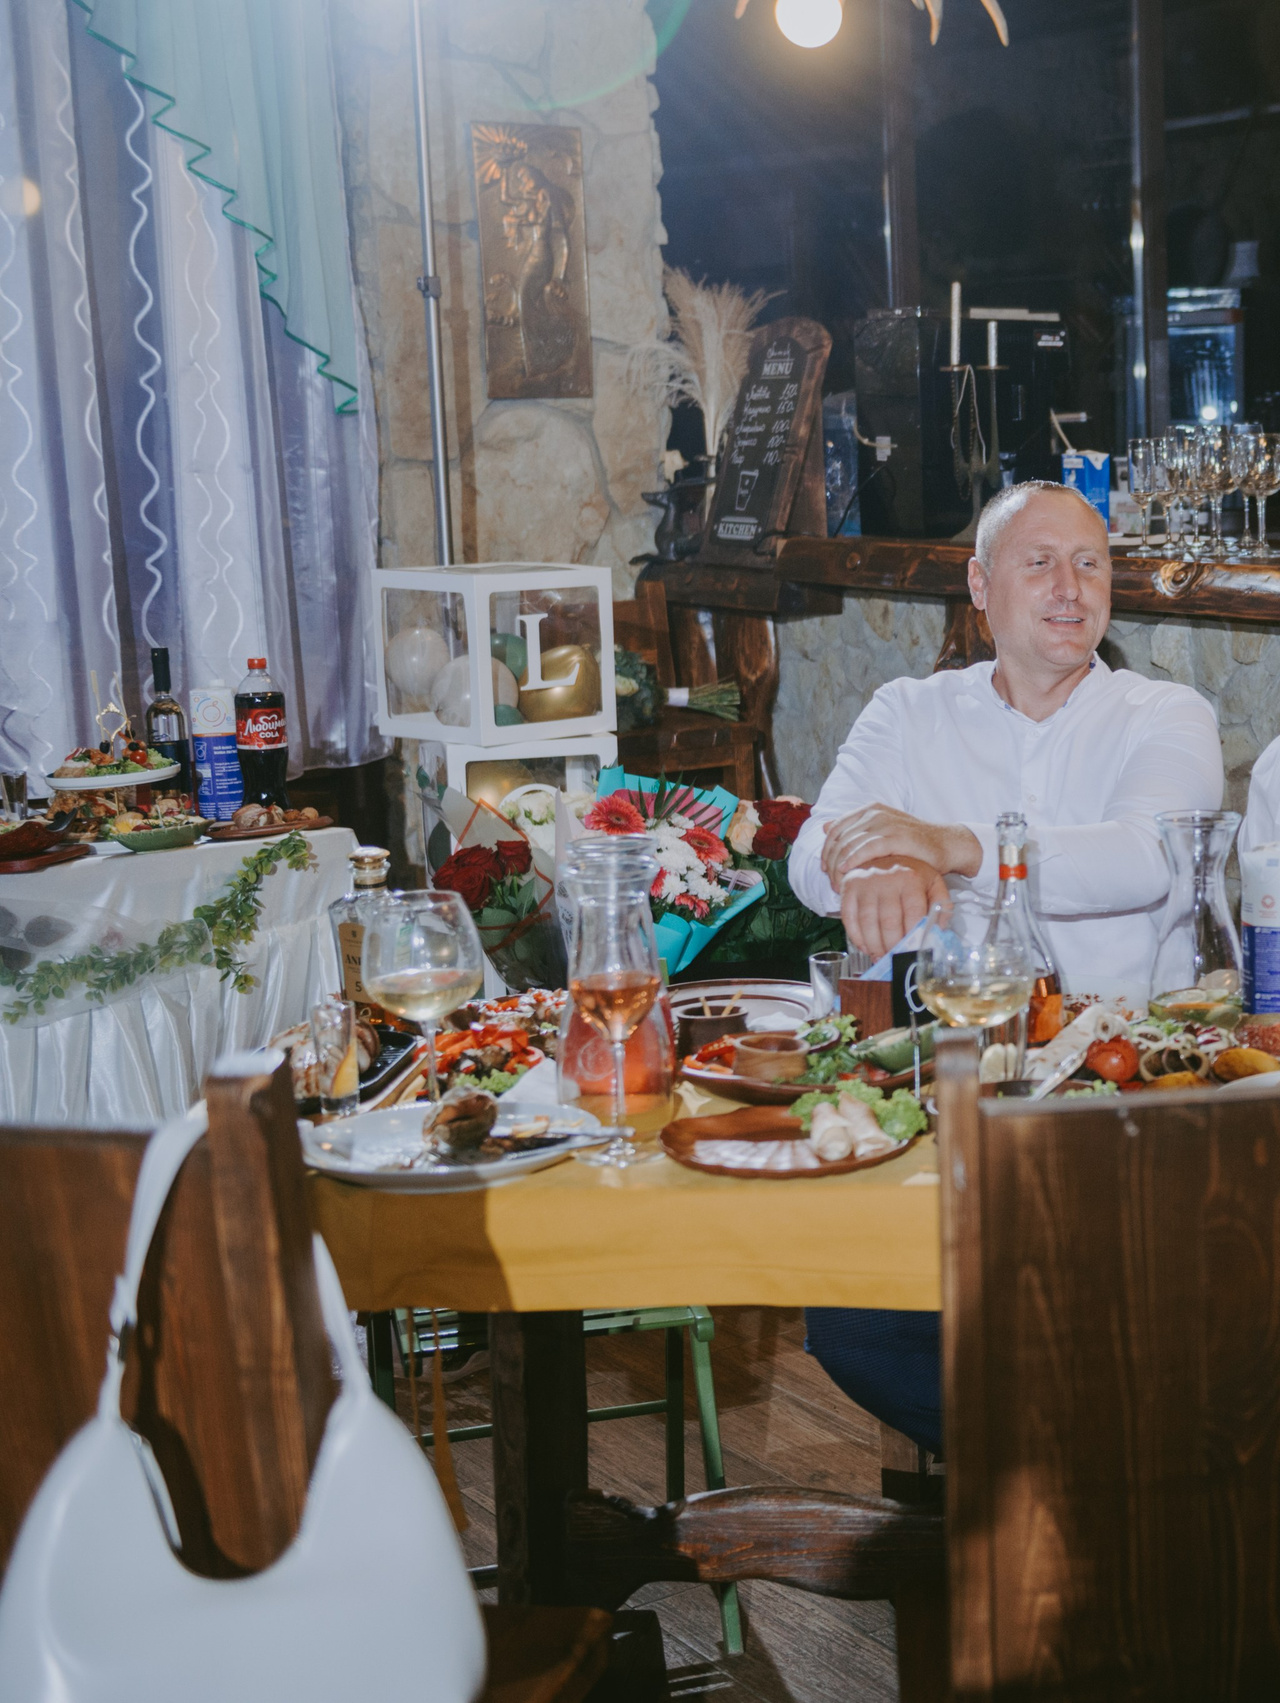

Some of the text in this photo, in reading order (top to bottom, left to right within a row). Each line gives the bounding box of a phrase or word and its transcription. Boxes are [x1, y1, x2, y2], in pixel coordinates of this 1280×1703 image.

[762, 361, 794, 376] MENU
[717, 522, 757, 536] KITCHEN
[515, 613, 581, 691] L
